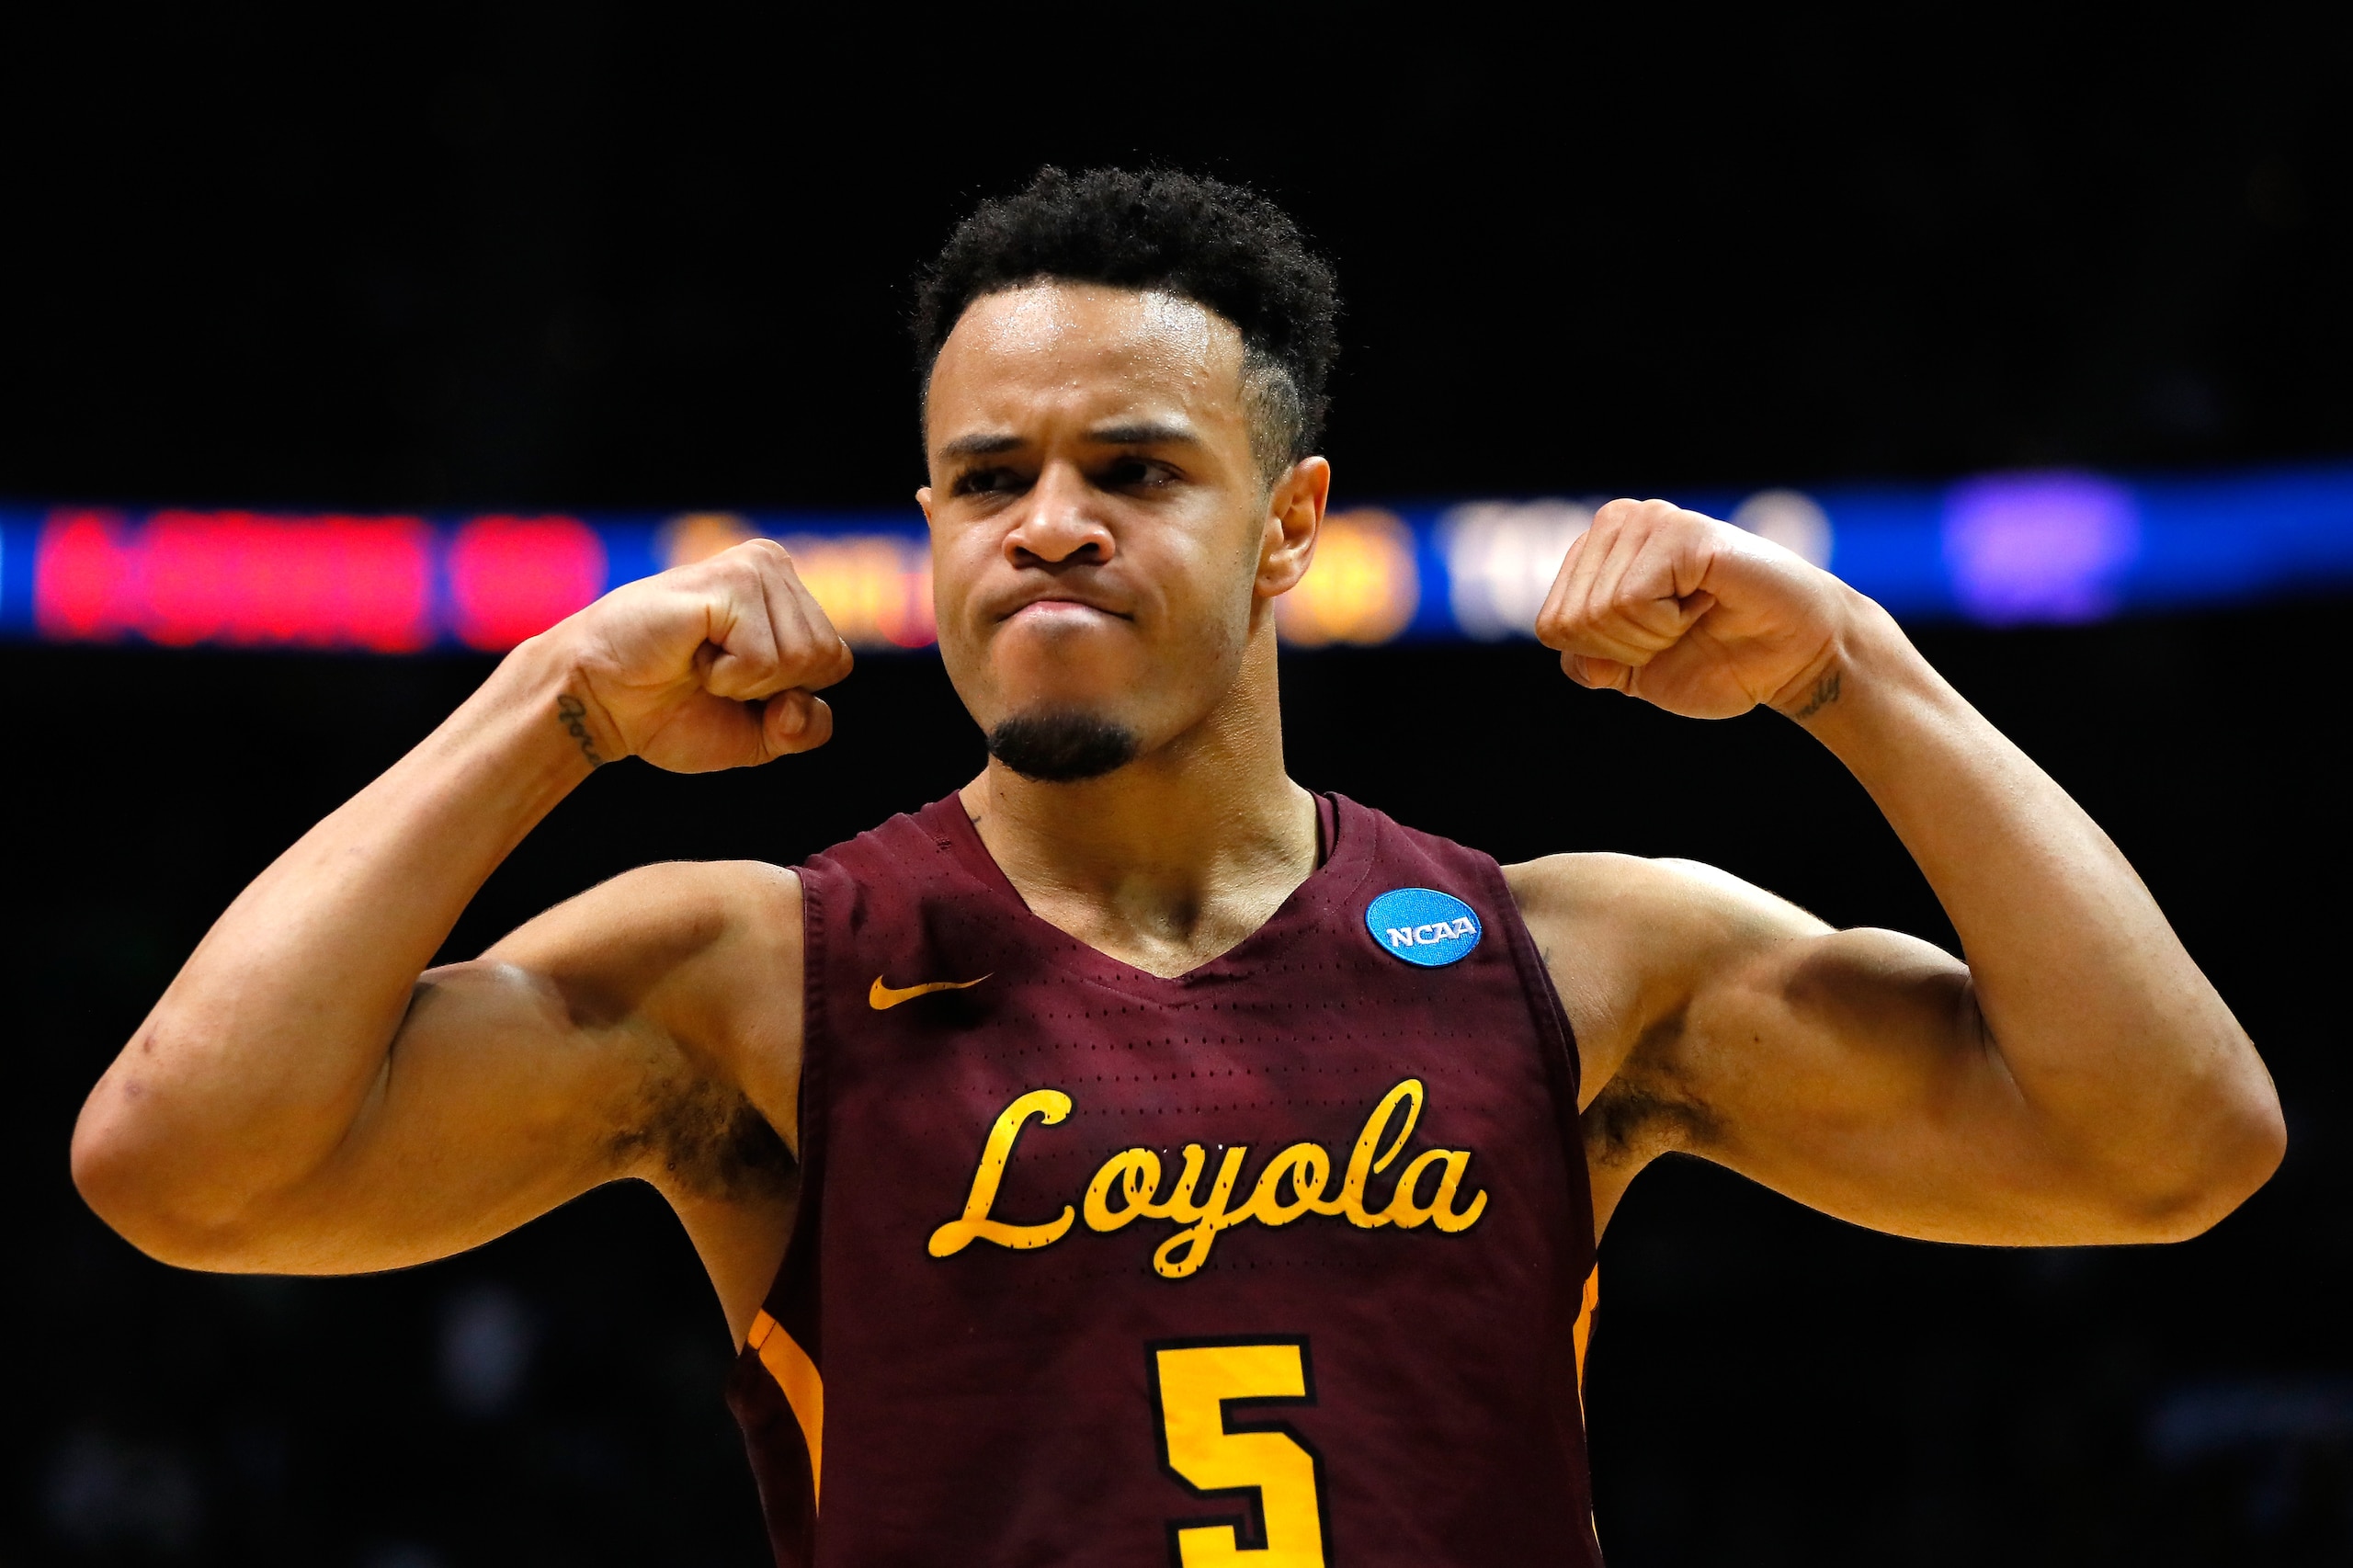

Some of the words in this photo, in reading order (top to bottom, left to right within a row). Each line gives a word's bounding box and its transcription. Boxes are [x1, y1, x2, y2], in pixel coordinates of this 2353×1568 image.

[1386, 915, 1477, 948] NCAA
[927, 1079, 1487, 1278] Loyola
[1155, 1344, 1325, 1568] 5
